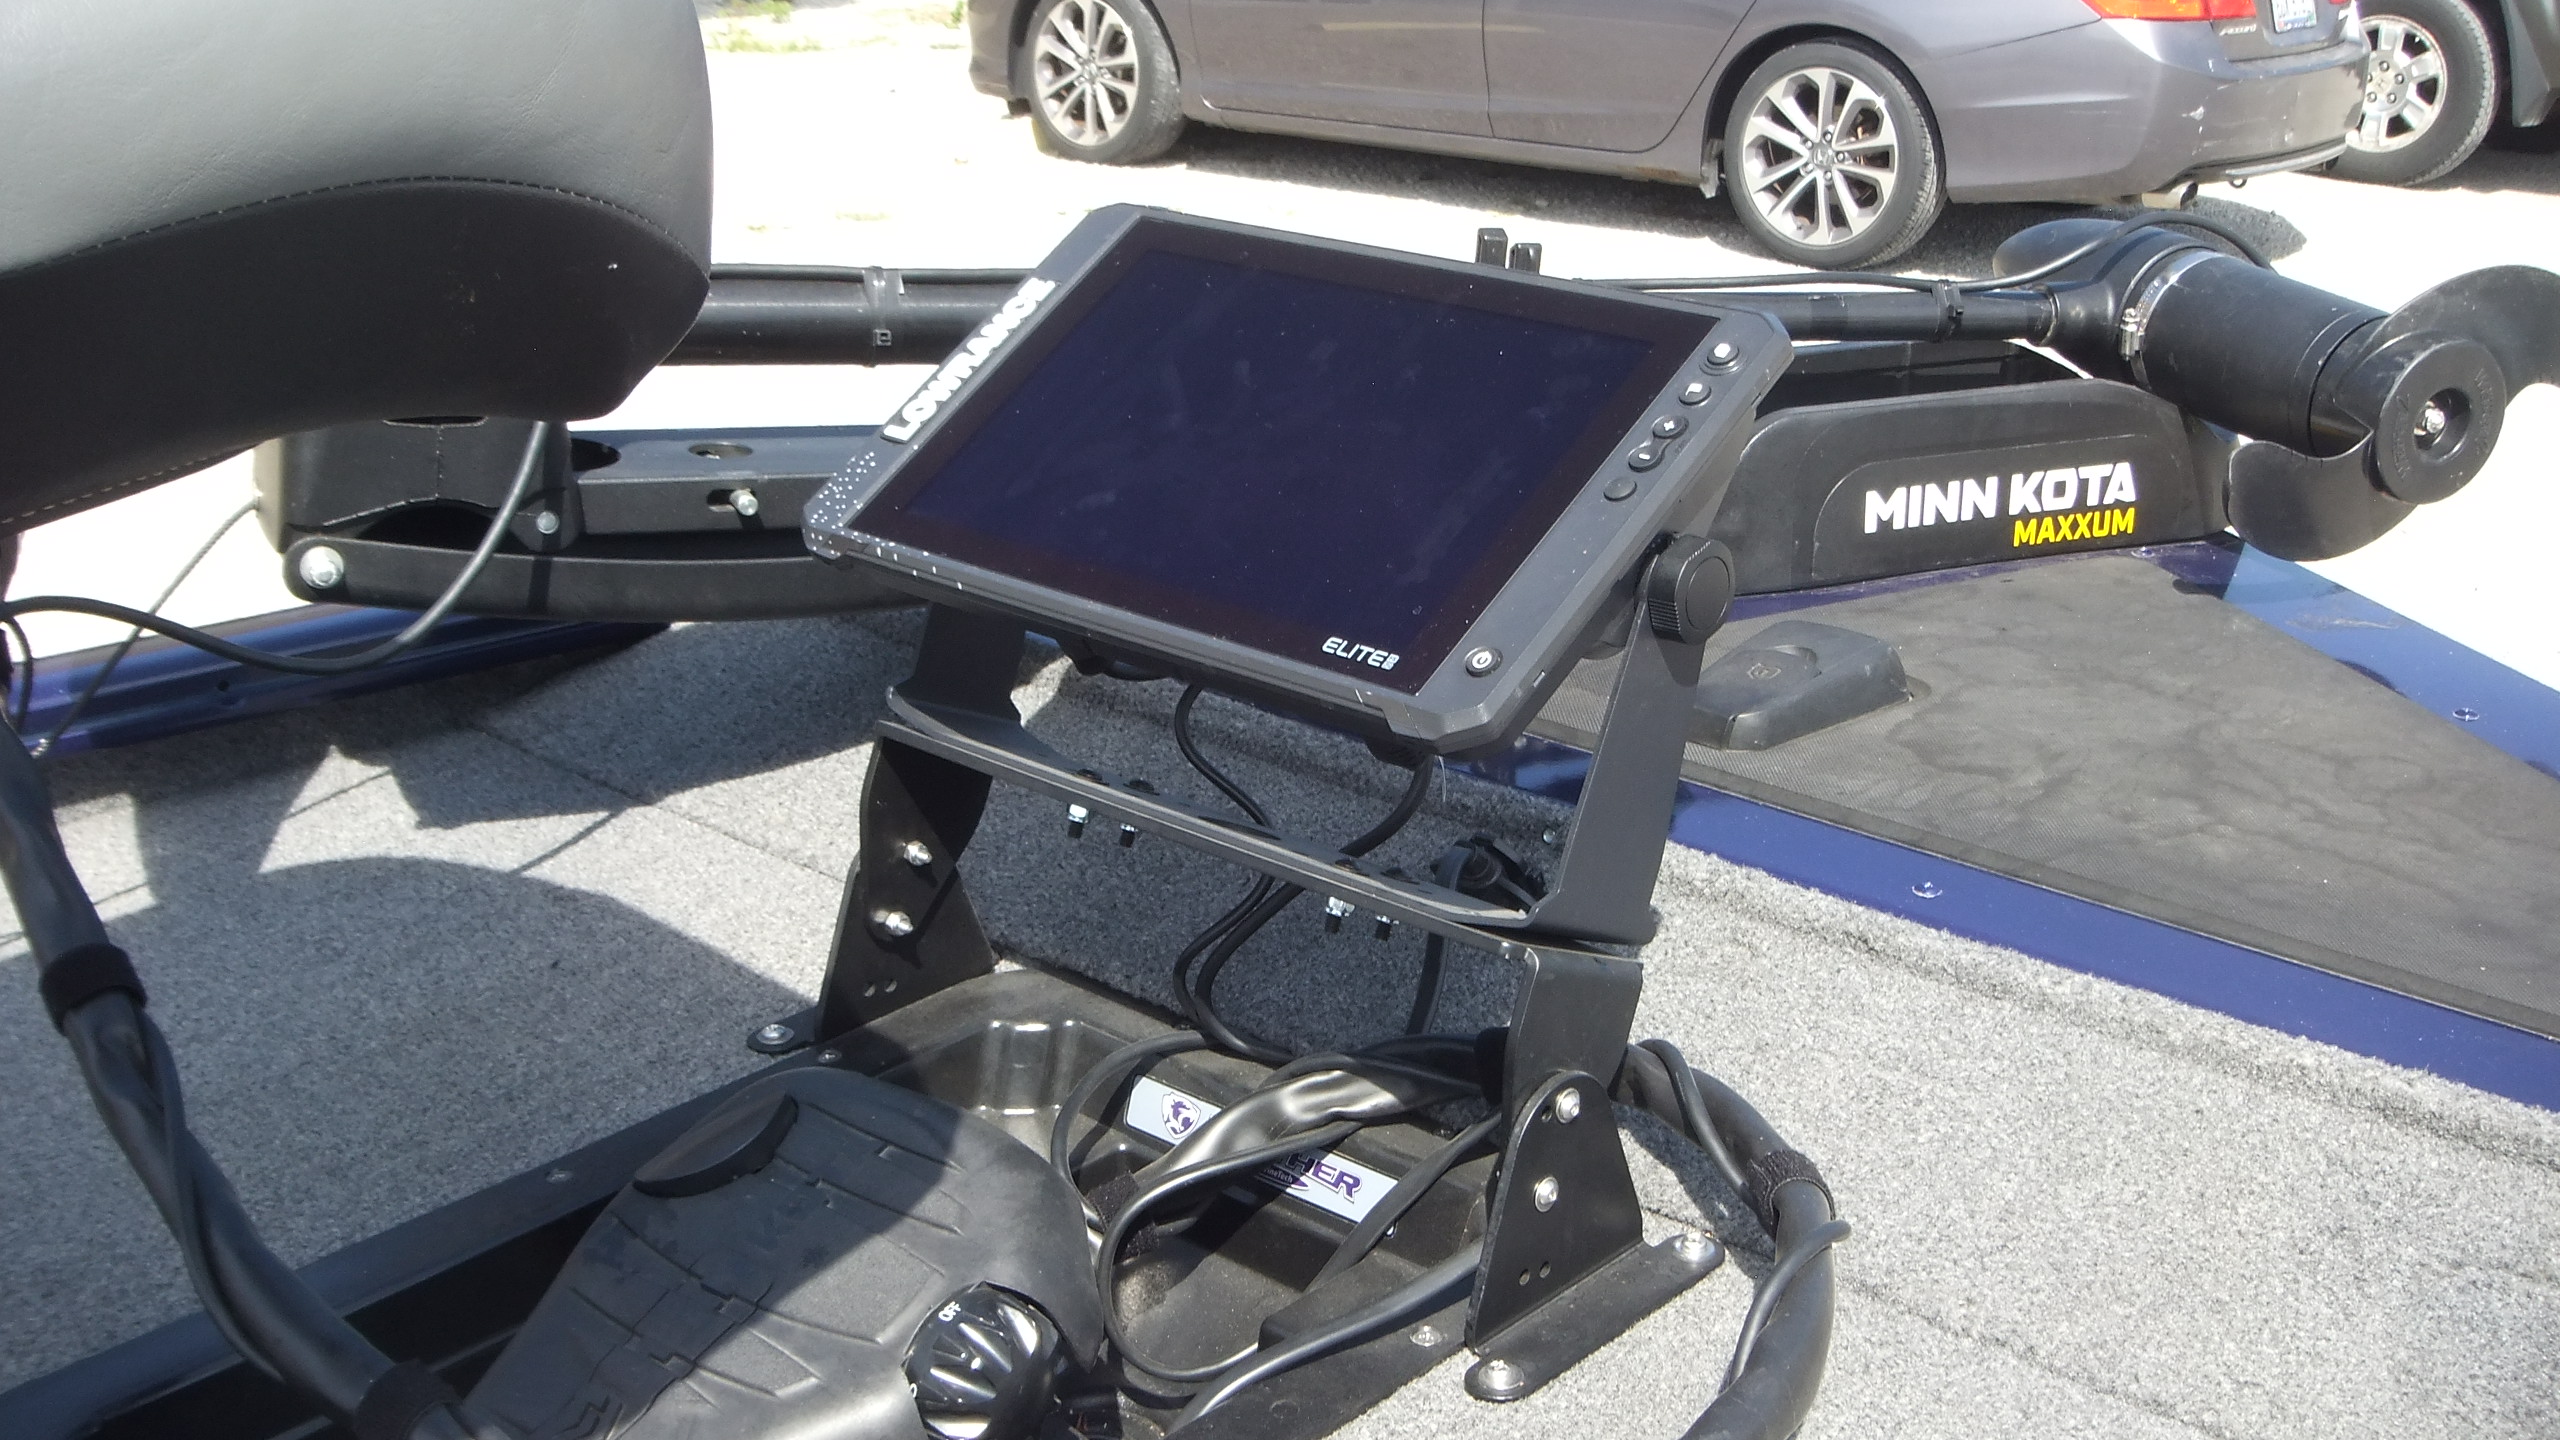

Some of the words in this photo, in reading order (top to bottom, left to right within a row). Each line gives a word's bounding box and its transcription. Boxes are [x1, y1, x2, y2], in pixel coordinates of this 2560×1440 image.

[883, 277, 1056, 441] LOWRANCE
[1864, 476, 1998, 534] MINN
[2008, 462, 2136, 516] KOTA
[2013, 507, 2136, 547] MAXXUM
[1322, 636, 1388, 668] ELITE
[1285, 1152, 1362, 1204] HER
[938, 1301, 962, 1322] OFF
